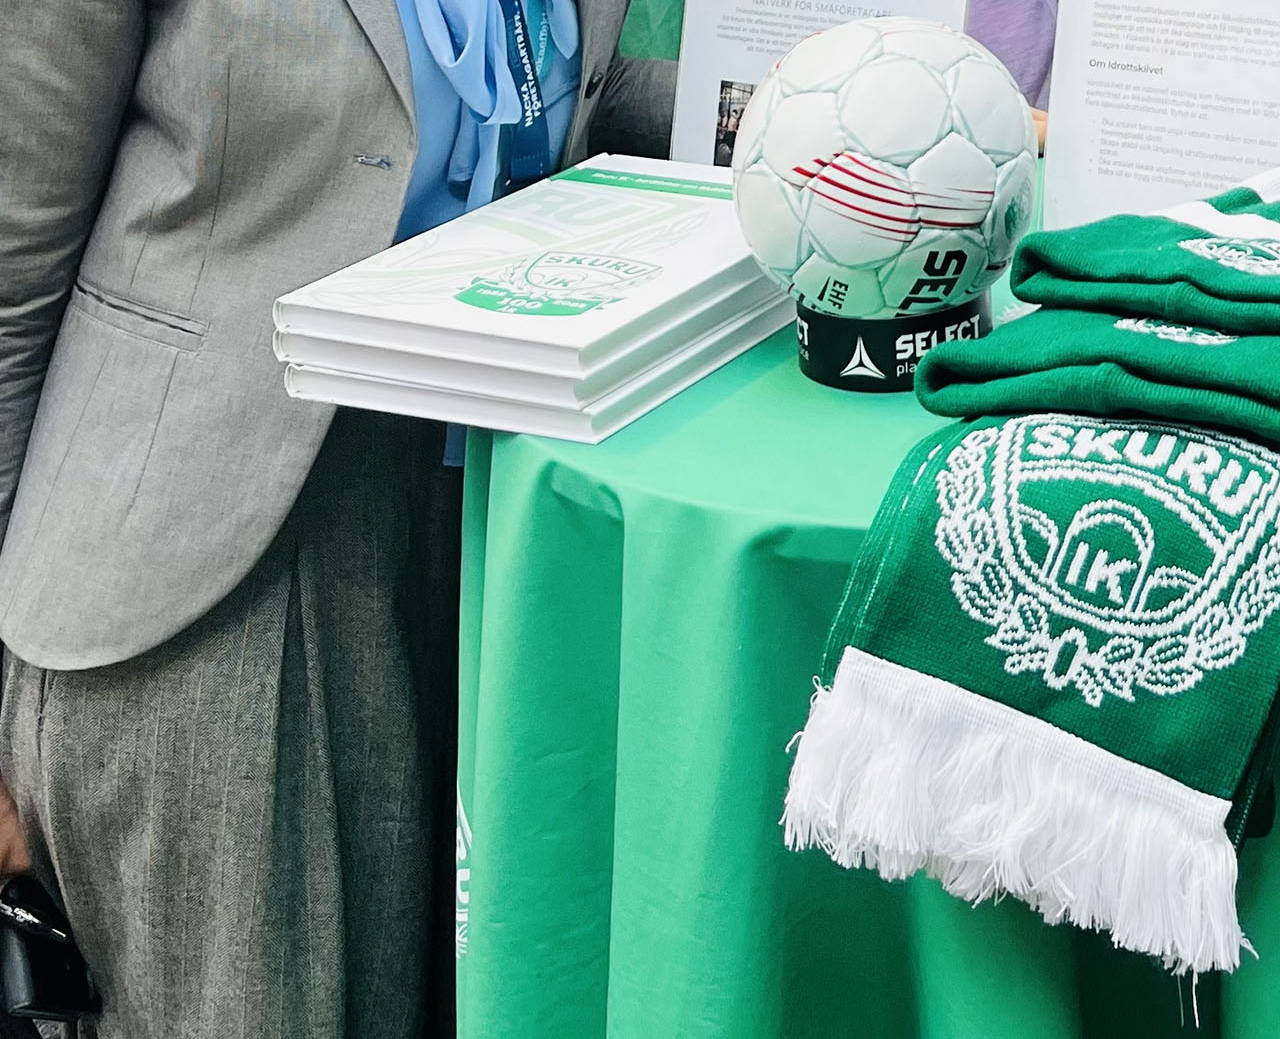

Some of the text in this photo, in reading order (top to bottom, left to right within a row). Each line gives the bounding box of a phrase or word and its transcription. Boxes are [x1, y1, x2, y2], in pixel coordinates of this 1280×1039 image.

[1089, 58, 1106, 70] Om
[545, 255, 649, 276] SKURU
[828, 279, 849, 310] EHF
[896, 249, 968, 317] SEL
[496, 296, 543, 310] 100
[1027, 423, 1264, 516] SKURU
[1066, 541, 1137, 604] IK
